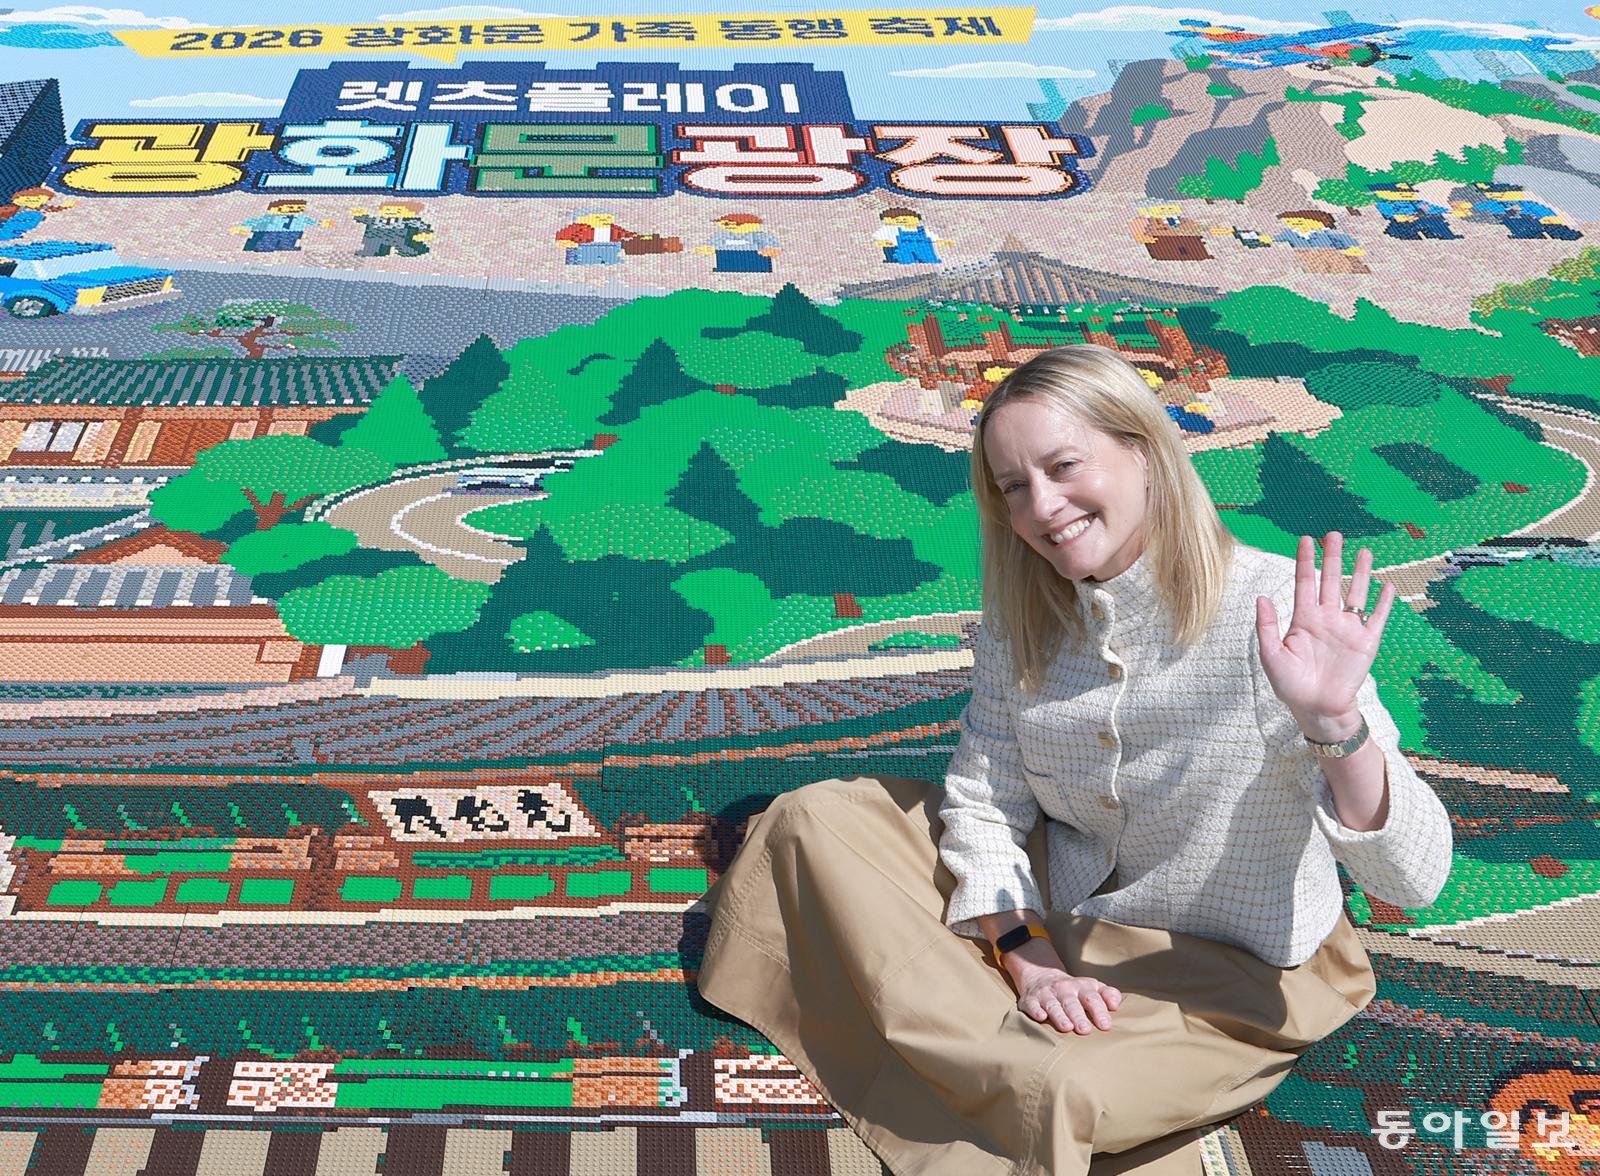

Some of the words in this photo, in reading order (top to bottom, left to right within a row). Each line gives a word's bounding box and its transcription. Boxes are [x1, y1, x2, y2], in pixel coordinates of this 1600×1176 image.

[169, 29, 323, 51] 2026
[345, 25, 545, 47] 광화문
[569, 21, 696, 43] 가족
[719, 18, 848, 41] 동행
[869, 15, 1003, 38] 축제
[335, 80, 800, 113] 렛츠플레이
[61, 122, 1080, 195] 광화문광장
